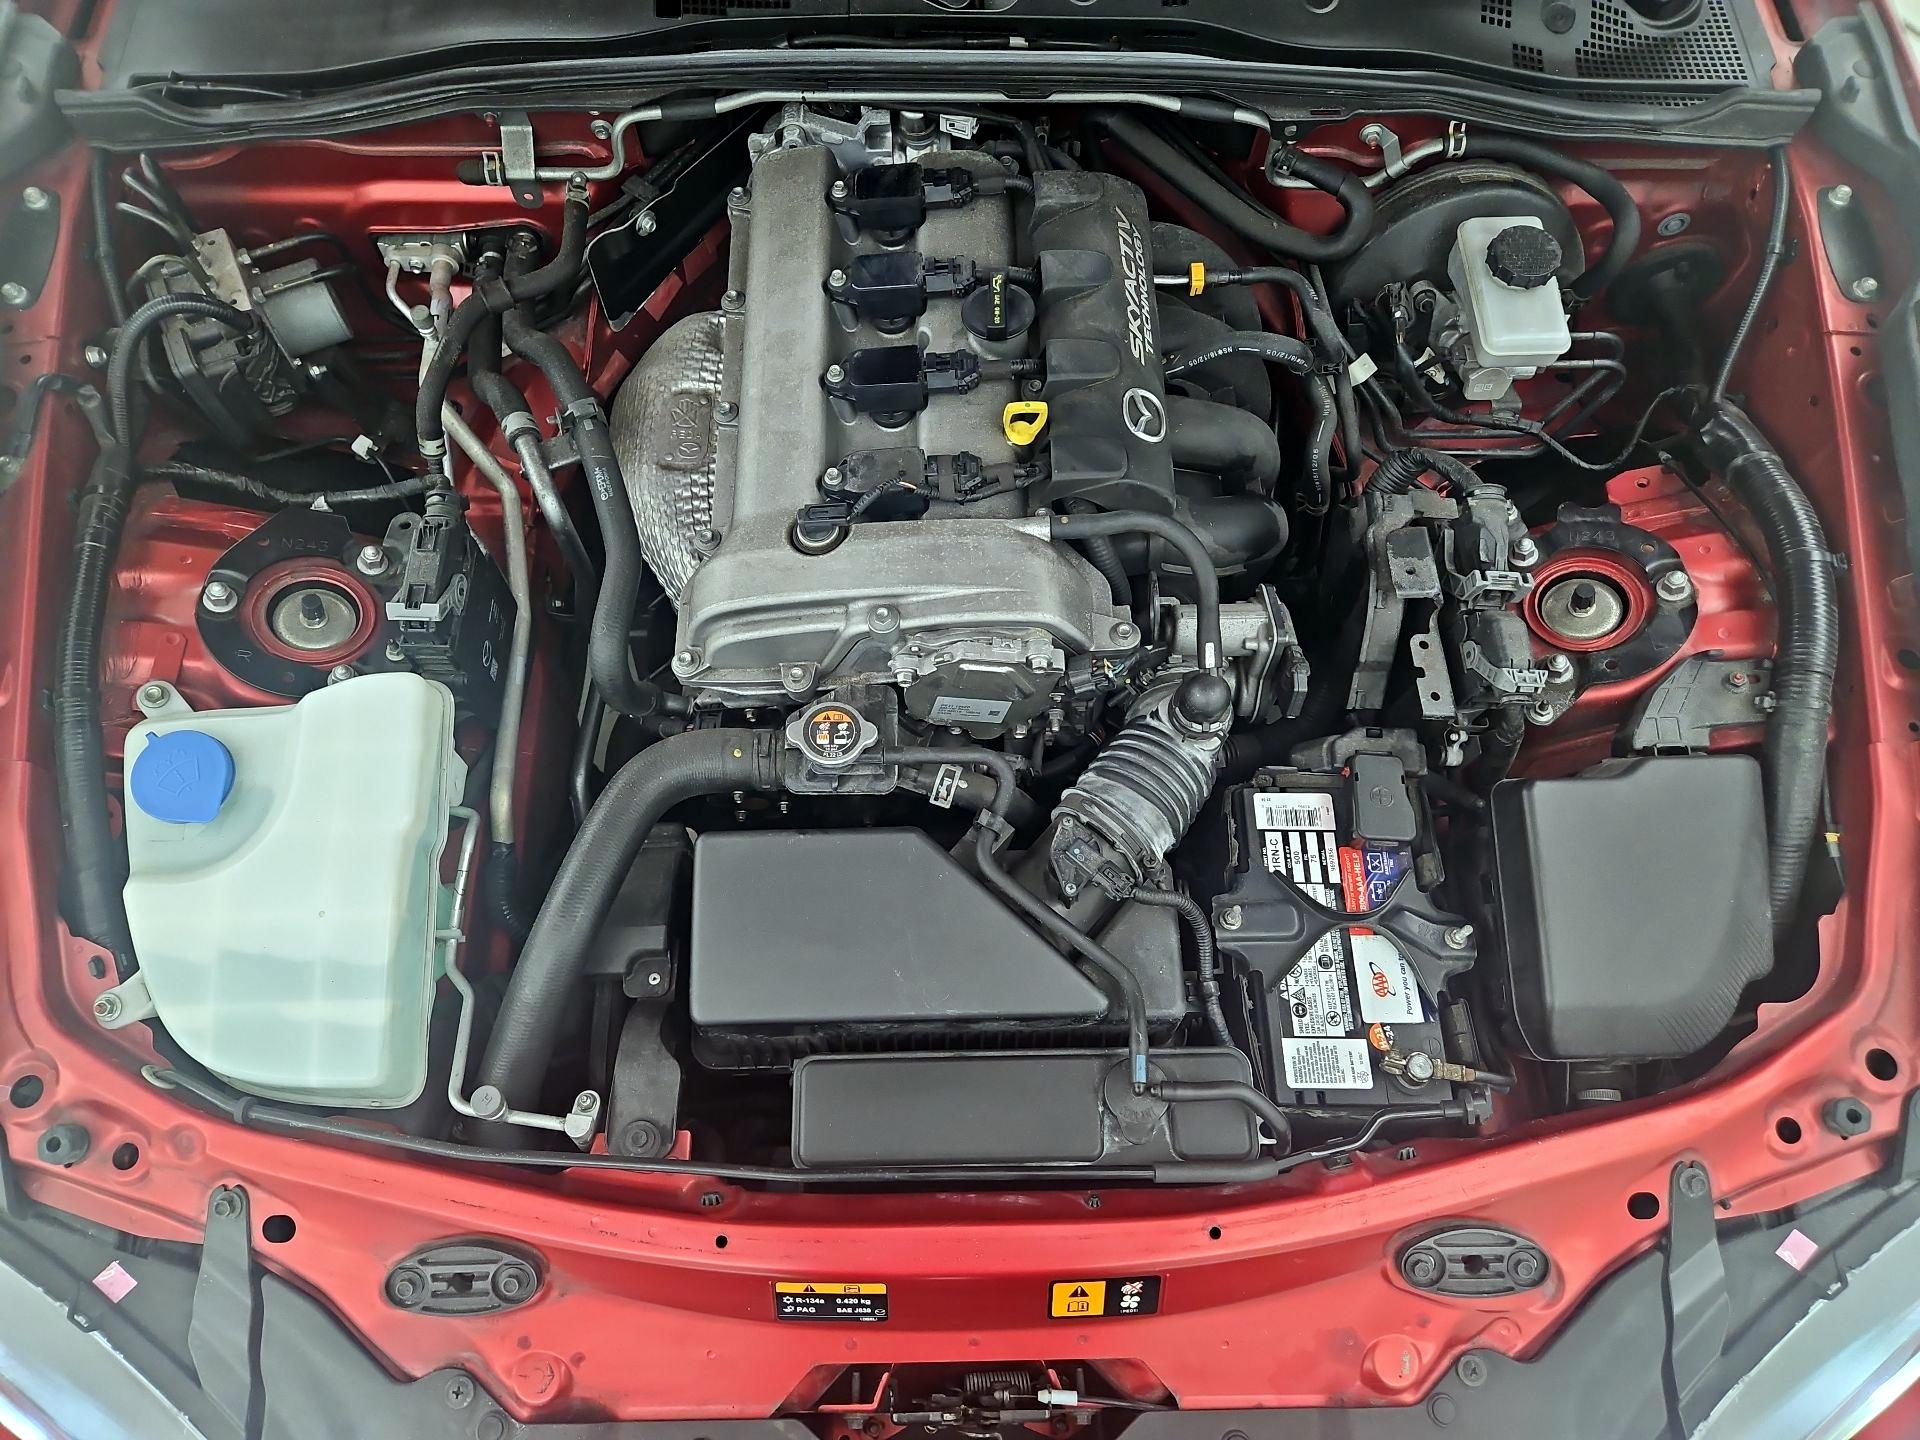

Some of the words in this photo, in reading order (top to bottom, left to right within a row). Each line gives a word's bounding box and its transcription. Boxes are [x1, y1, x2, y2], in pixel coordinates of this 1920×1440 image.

[1115, 206, 1145, 366] SKYACTIV
[1131, 224, 1154, 354] TECHNOLOGY
[1310, 855, 1317, 863] 75
[1402, 977, 1410, 990] you
[1405, 992, 1413, 1015] Power
